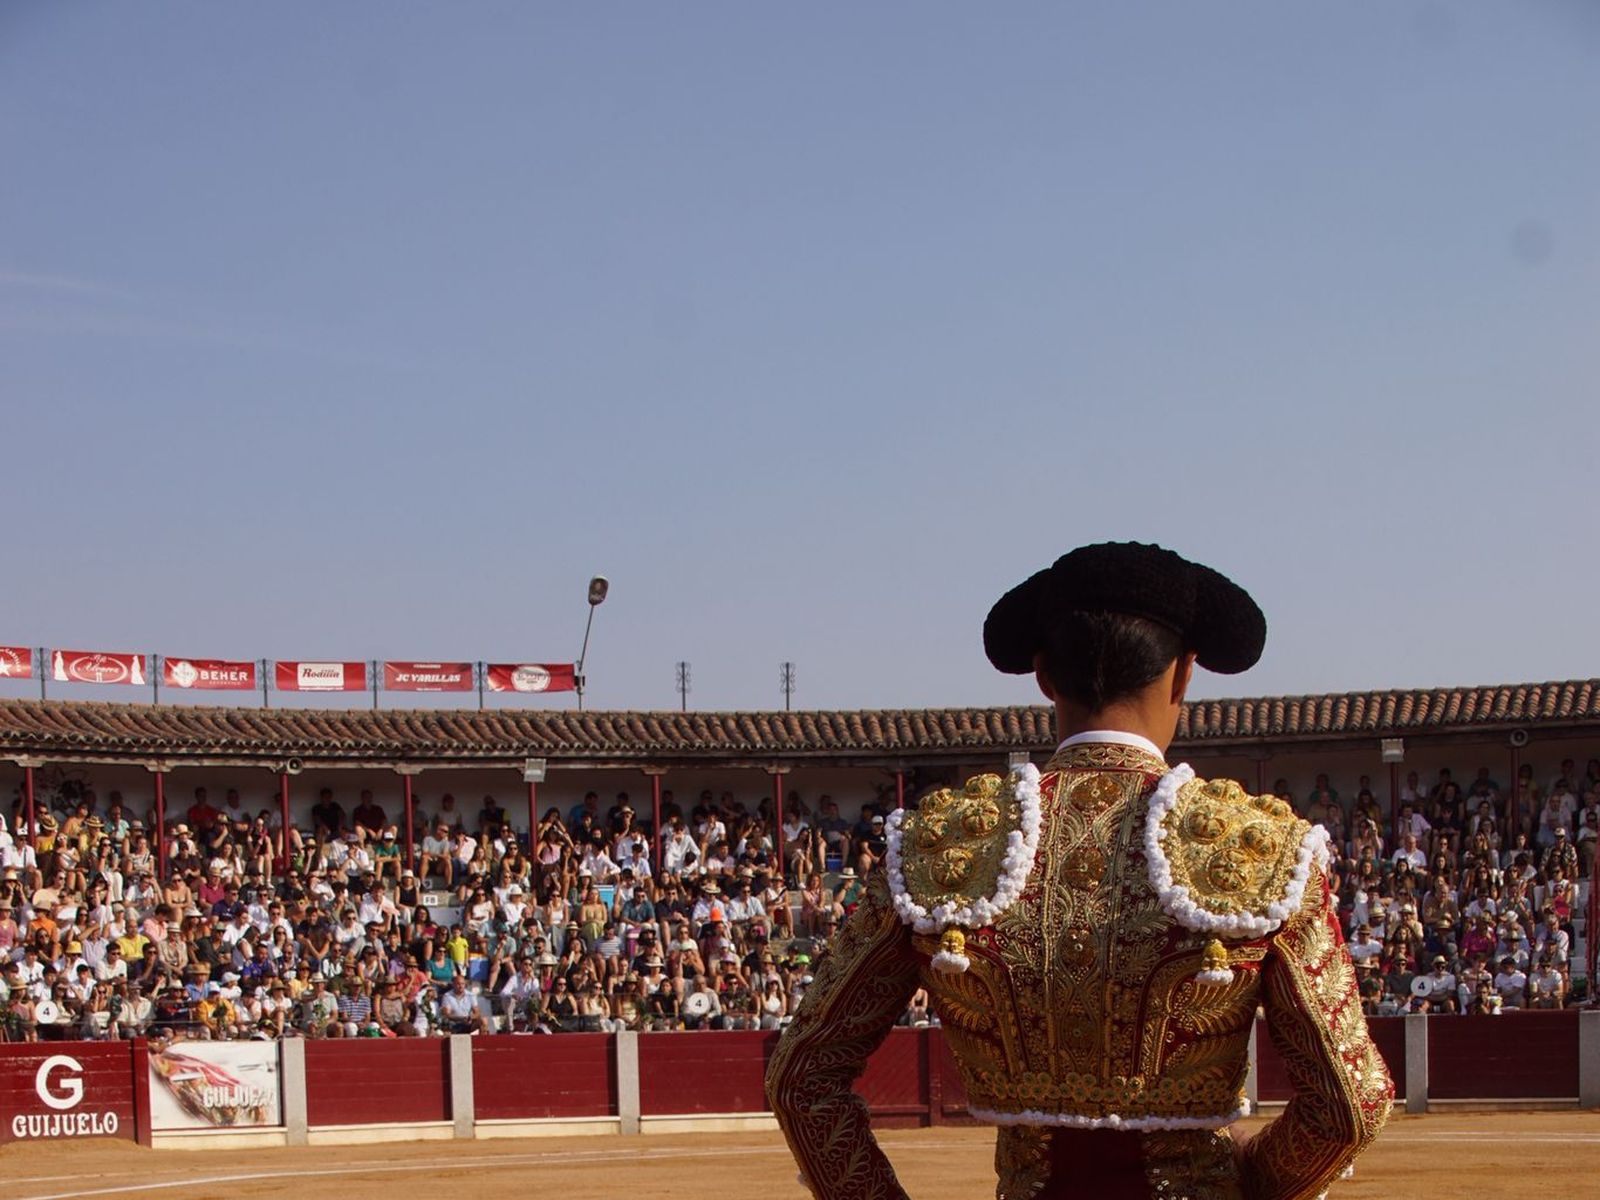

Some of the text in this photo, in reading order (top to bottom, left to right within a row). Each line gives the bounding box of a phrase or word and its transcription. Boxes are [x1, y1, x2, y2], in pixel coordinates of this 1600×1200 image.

[200, 669, 249, 681] BEHER
[395, 673, 461, 682] JC VARILLAS
[1418, 982, 1425, 990] 4
[695, 999, 702, 1007] 4
[43, 1007, 50, 1015] 4
[36, 1054, 84, 1110] G
[12, 1111, 119, 1138] GUIJUELO
